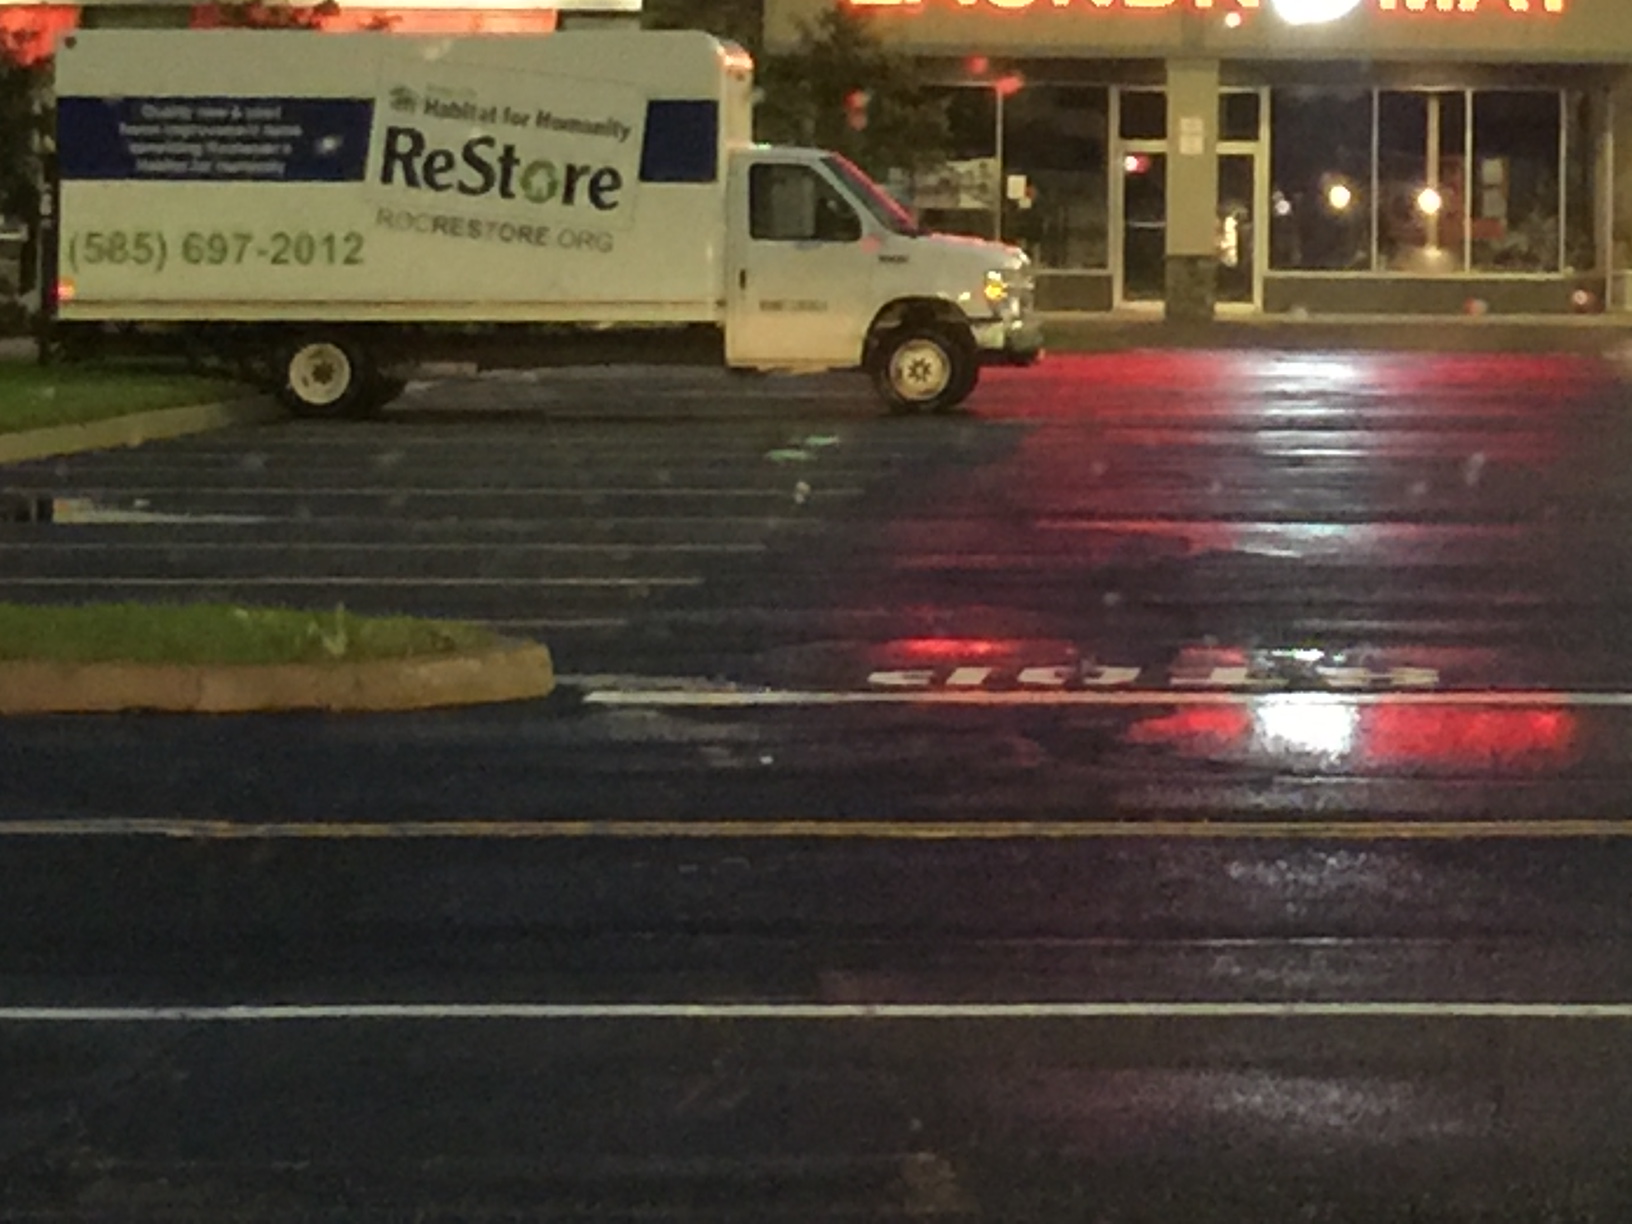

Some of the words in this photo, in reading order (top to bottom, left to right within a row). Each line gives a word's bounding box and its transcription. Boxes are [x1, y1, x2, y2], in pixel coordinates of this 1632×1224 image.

[423, 96, 498, 124] Habitat
[503, 105, 530, 126] for
[535, 108, 632, 143] Humanity
[380, 126, 623, 211] ReStore
[68, 228, 168, 272] (585)
[181, 228, 365, 265] 697-2012
[375, 207, 615, 253] ROCRESTOREORG
